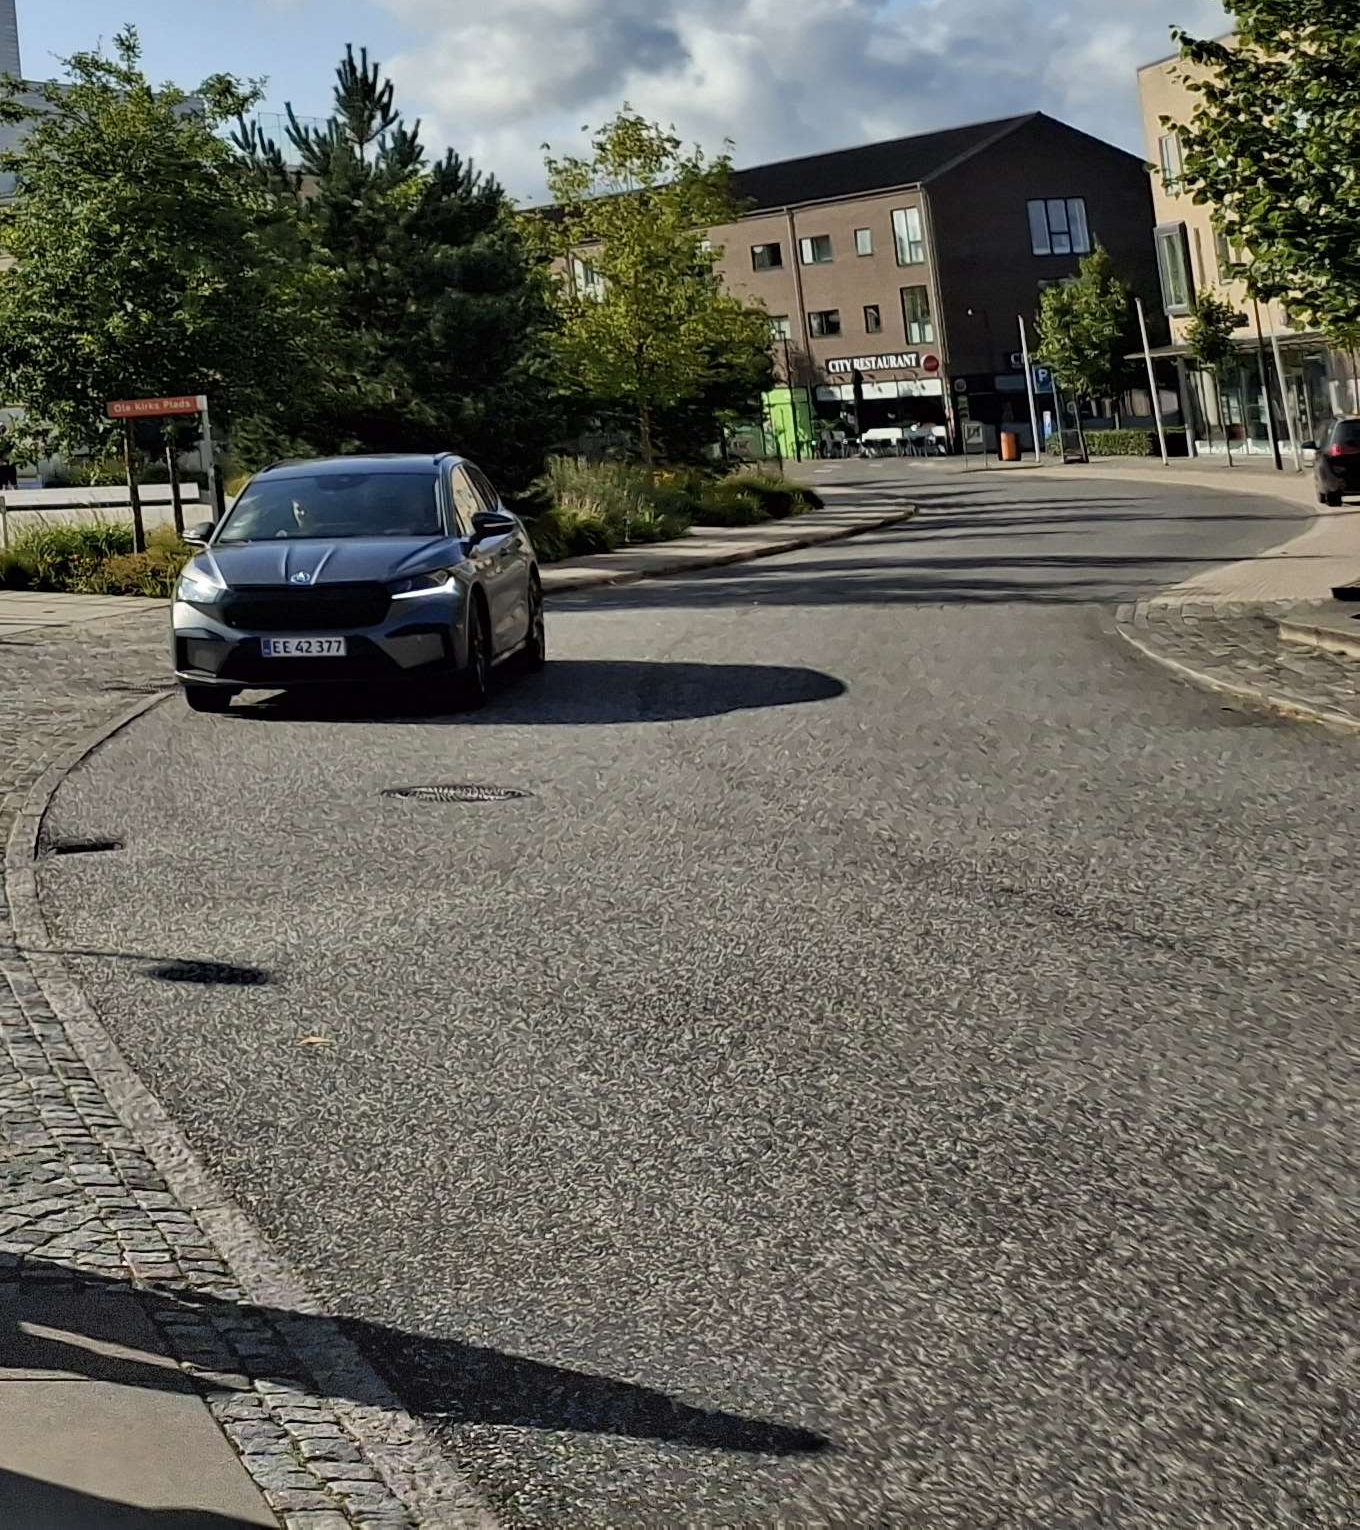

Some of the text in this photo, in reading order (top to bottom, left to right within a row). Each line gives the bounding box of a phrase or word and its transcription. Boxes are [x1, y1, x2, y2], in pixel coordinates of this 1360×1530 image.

[828, 353, 917, 373] CITY RESTAURANT
[1038, 368, 1048, 382] P
[113, 403, 131, 413] Ole
[134, 401, 160, 411] Kirks
[272, 640, 342, 654] EE 42 377
